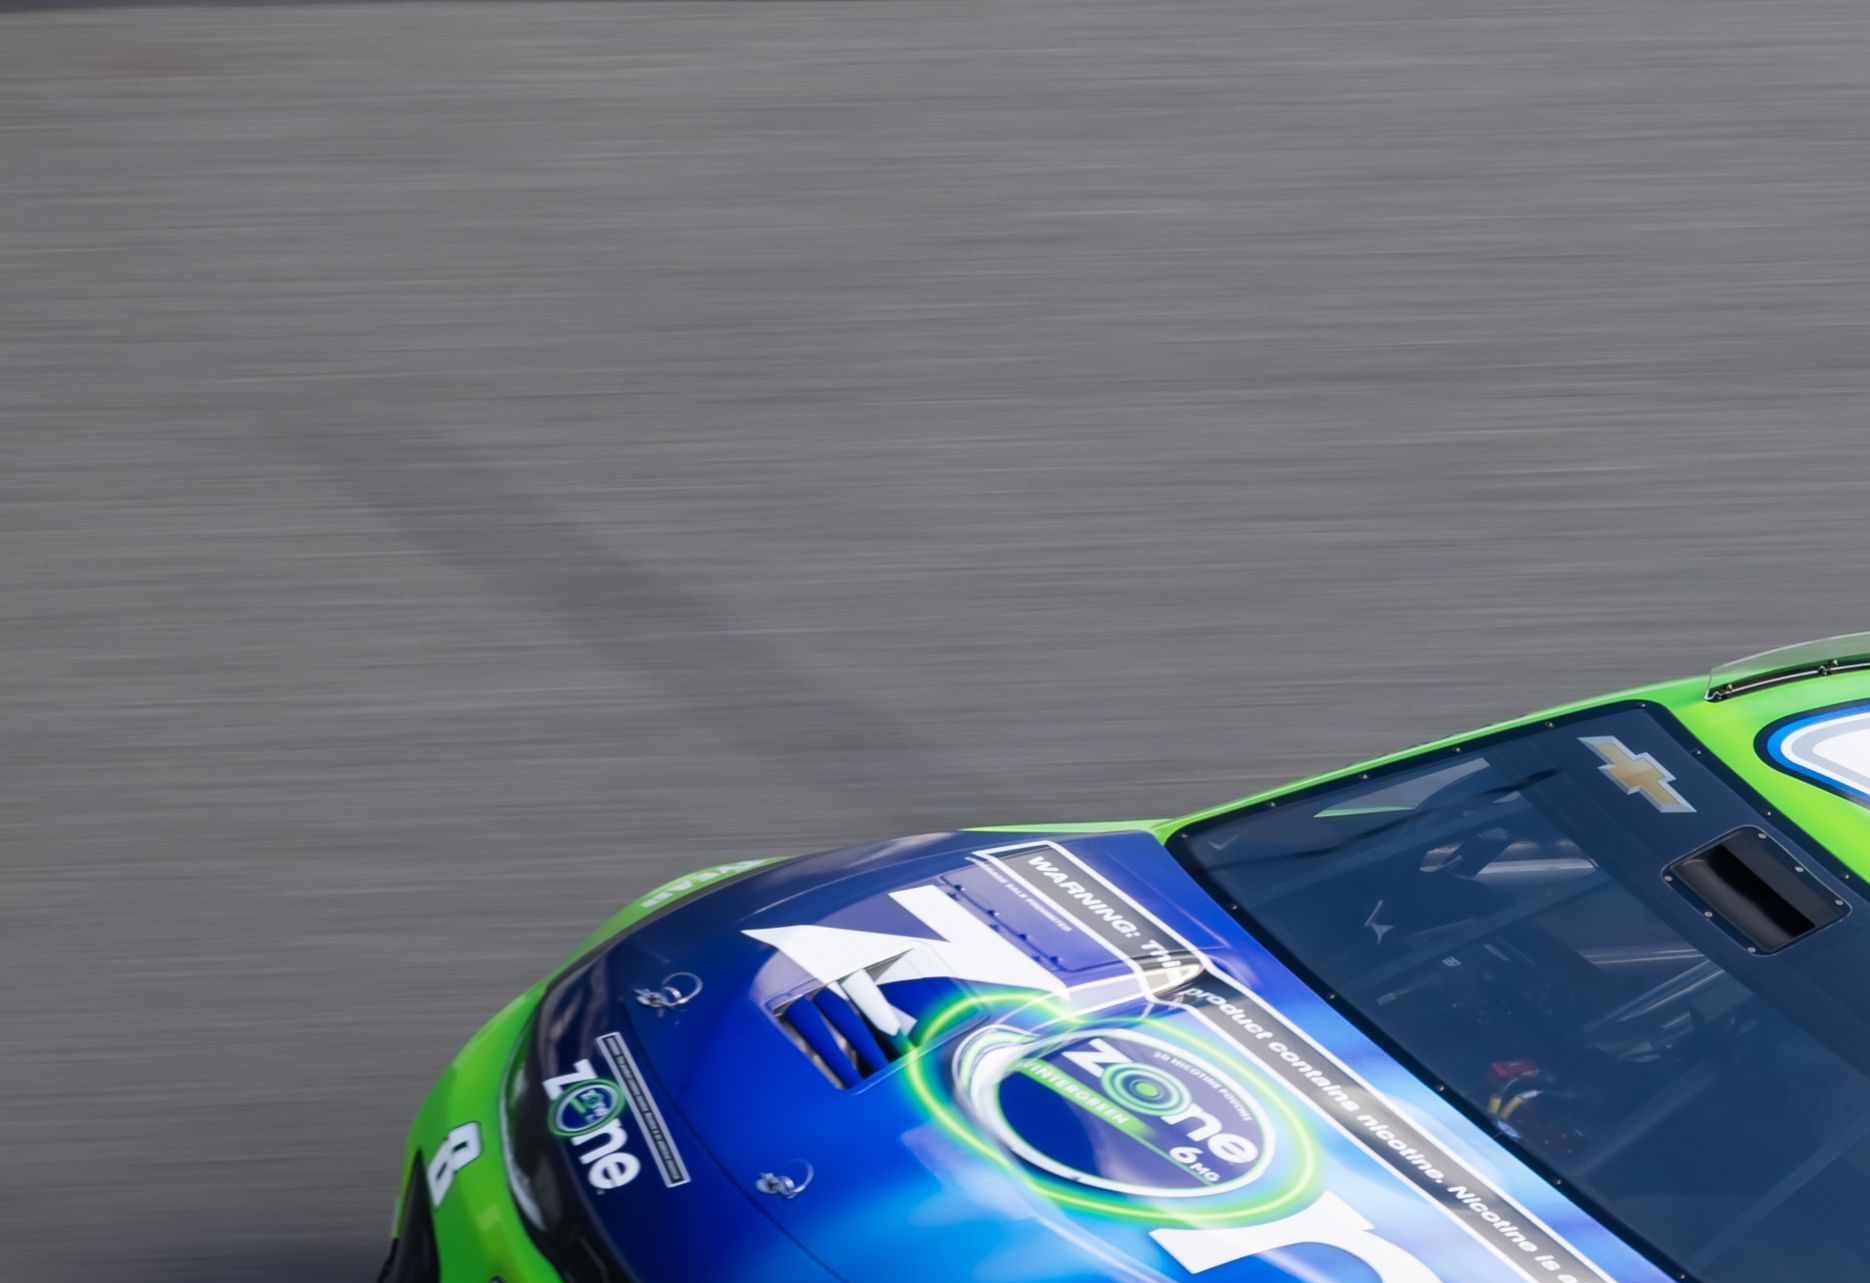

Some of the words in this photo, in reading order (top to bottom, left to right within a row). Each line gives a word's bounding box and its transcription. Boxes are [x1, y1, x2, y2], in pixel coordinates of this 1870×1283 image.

[1028, 856, 1141, 939] WARNING:
[1268, 1039, 1360, 1113] contains
[1357, 1114, 1444, 1184] nicotine.
[1446, 1184, 1538, 1253] Nicotine
[1534, 1254, 1561, 1273] is
[1062, 1038, 1259, 1164] zone
[428, 1121, 482, 1210] 8
